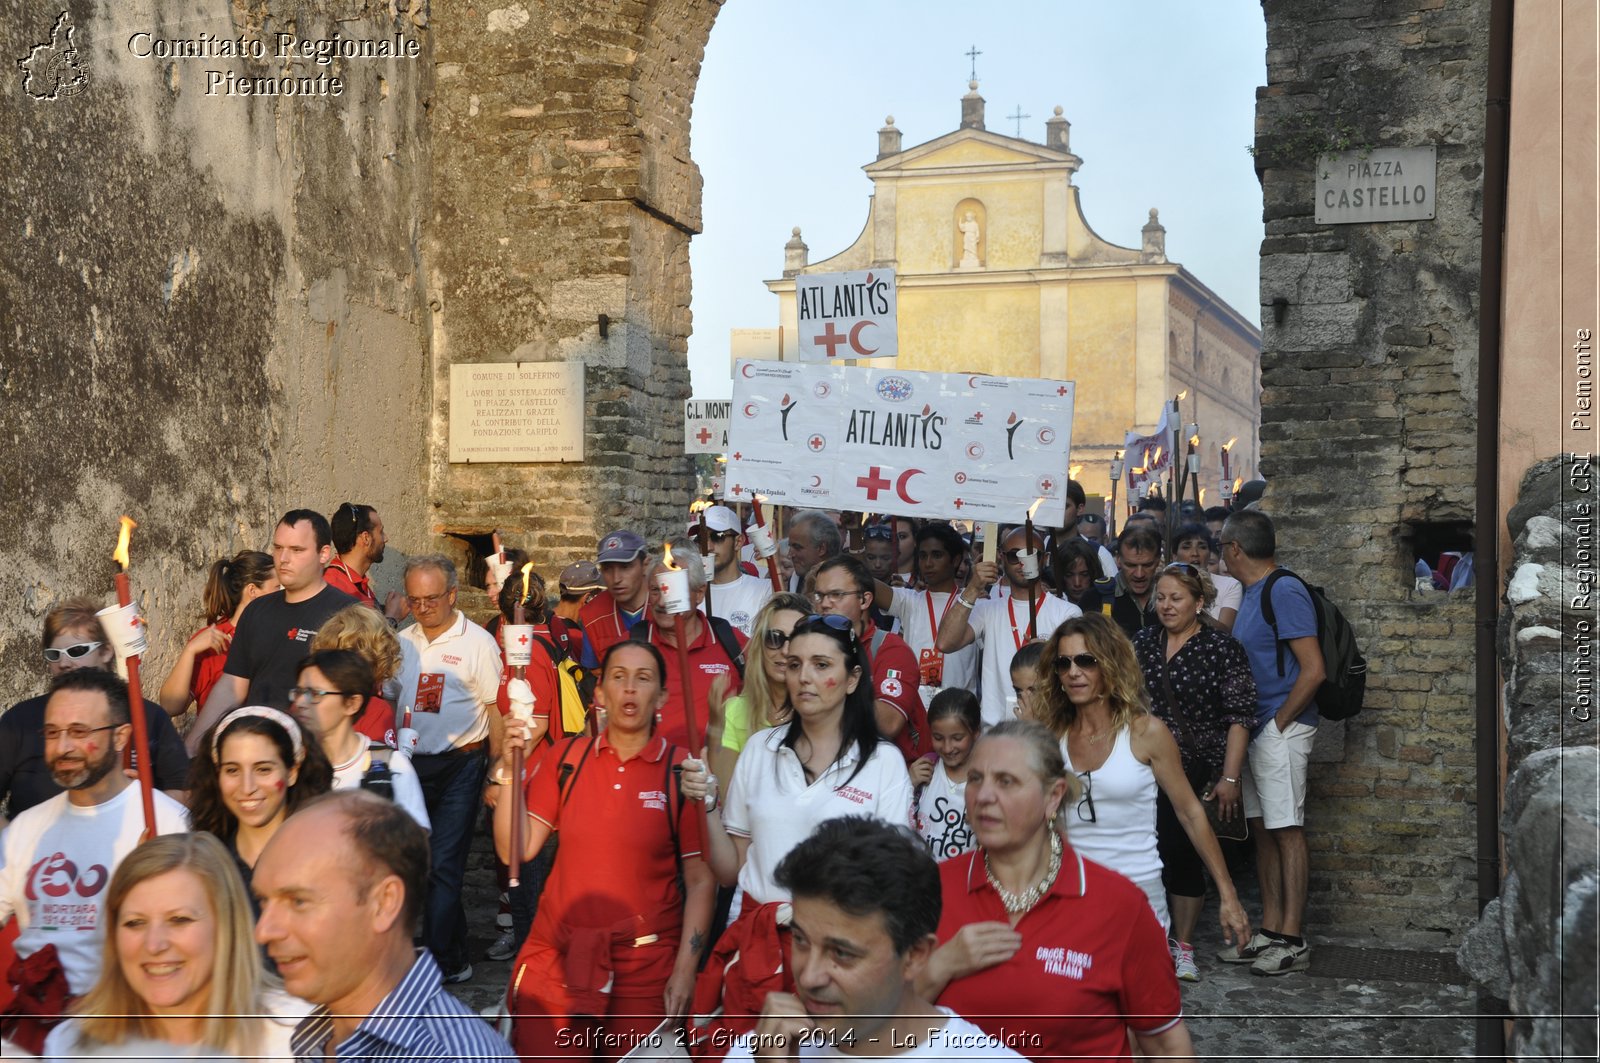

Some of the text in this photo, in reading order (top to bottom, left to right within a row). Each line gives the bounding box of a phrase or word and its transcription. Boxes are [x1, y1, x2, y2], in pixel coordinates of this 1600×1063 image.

[1347, 160, 1403, 179] PIAZZA
[1323, 184, 1426, 208] CASTELLO
[472, 371, 561, 381] COMUNE DI SOLFERINO
[465, 388, 567, 398] LAVORI DI SISTEMAZIONE
[473, 398, 559, 407] DI PIAZZA CASTELLO
[476, 408, 556, 417] REALIZZATI GRAZIE
[687, 402, 703, 419] C.L.
[705, 402, 732, 420] MONT
[471, 418, 561, 427] AL CONTRIBUTO DELLA
[846, 403, 944, 450] ATLANTIS
[473, 428, 559, 437] FONDAZIONE CARIPLO
[836, 791, 864, 804] ITALIANA
[43, 903, 97, 914] MORTARA
[42, 915, 97, 926] 1914-2014
[1036, 946, 1092, 969] CROCE ROSSA
[1044, 959, 1083, 980] ITALIANA
